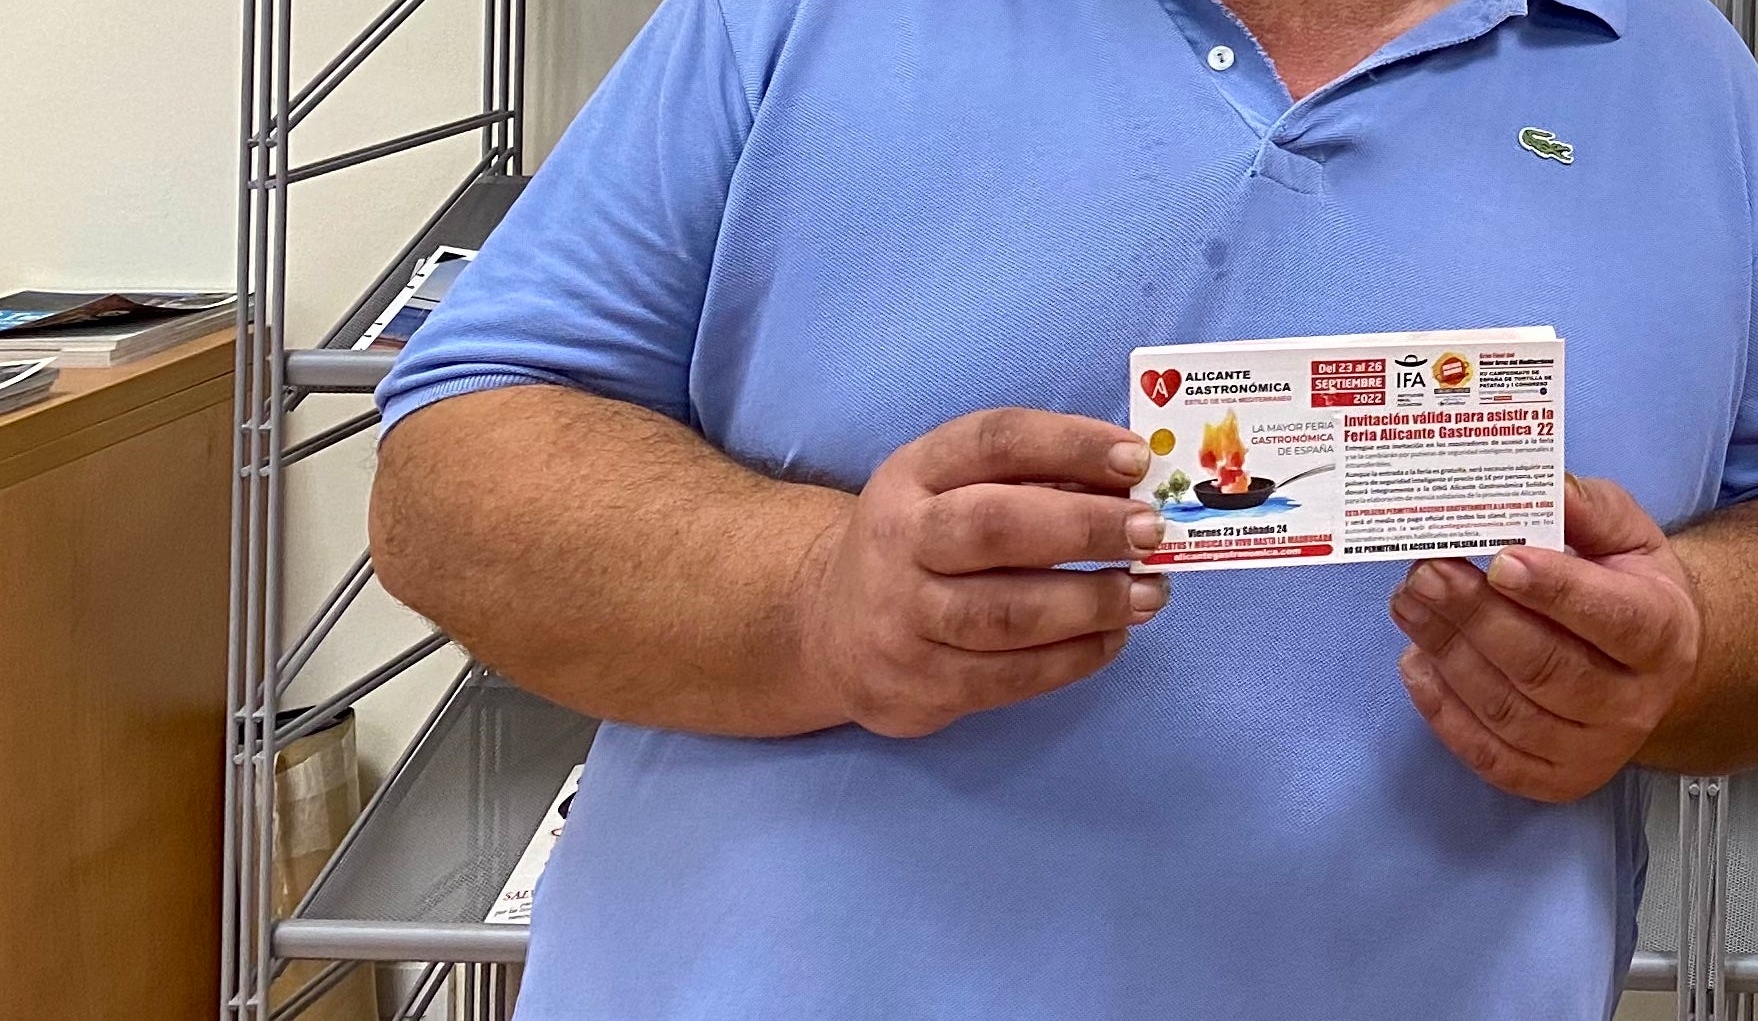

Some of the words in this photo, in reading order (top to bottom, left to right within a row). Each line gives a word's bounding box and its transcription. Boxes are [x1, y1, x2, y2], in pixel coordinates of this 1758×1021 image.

[1318, 363, 1335, 373] Del
[1338, 363, 1352, 372] 23
[1355, 362, 1364, 372] al
[1367, 362, 1381, 371] 26
[1185, 370, 1250, 381] ALICANTE
[1397, 371, 1425, 387] IFA
[1185, 380, 1291, 395] GASTRONÓMICA
[1315, 377, 1381, 389] SEPTIEMBRE
[1353, 393, 1381, 403] 2022
[1344, 412, 1409, 426] Invitación
[1412, 410, 1451, 424] válida
[1455, 412, 1483, 424] para
[1487, 407, 1528, 421] asistir
[1531, 410, 1538, 420] a
[1542, 406, 1553, 419] la
[1252, 424, 1264, 433] LA
[1267, 422, 1303, 432] MAYOR
[1305, 421, 1333, 431] FERIA
[1344, 429, 1376, 442] Feria
[1380, 426, 1434, 441] Alicante
[1439, 423, 1531, 438] Gastronómica
[1537, 422, 1553, 435] 22
[1251, 432, 1333, 444] GASTRONÓMICA
[1278, 447, 1291, 455] DE
[1294, 443, 1333, 454] ESPAÑA
[1188, 528, 1221, 537] Viernes
[1223, 526, 1233, 535] 23
[1236, 528, 1240, 536] y
[1242, 525, 1274, 535] Sábado
[1276, 524, 1287, 533] 24
[502, 890, 533, 901] SAL
